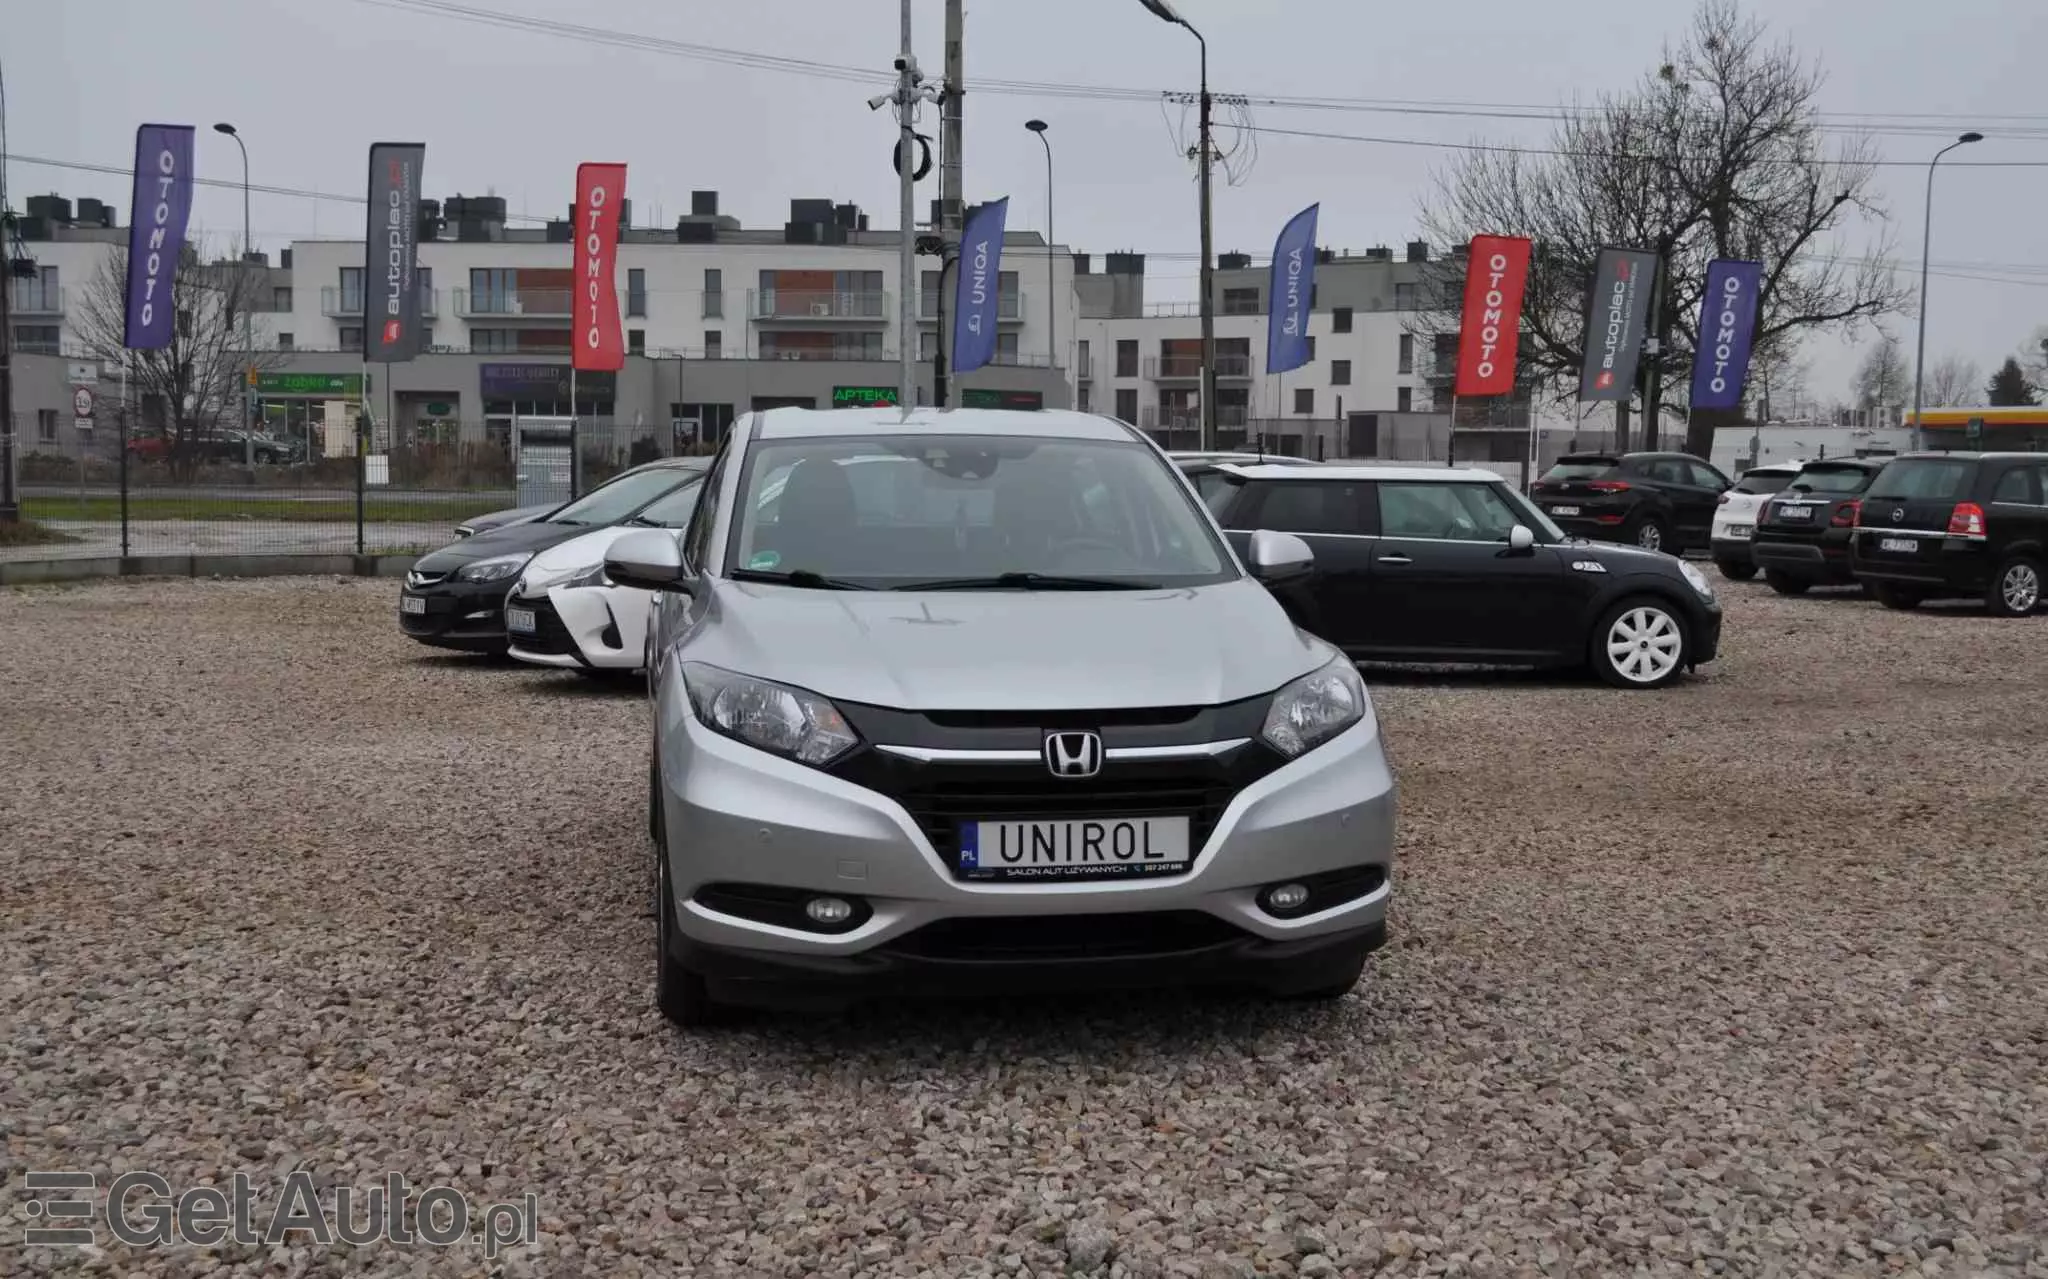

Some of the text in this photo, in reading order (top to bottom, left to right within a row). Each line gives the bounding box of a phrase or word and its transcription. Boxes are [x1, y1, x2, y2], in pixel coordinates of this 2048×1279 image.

[141, 150, 174, 327] OTOMOTO
[587, 185, 606, 349] OTOMOTO
[971, 240, 988, 304] UNIQA
[1287, 247, 1303, 308] UNIQA
[1477, 254, 1506, 378] OTOMOTO
[1710, 276, 1740, 393] OTOMOTO
[834, 389, 897, 402] APTEKA
[961, 850, 976, 861] PL
[1000, 821, 1164, 863] UNIROL
